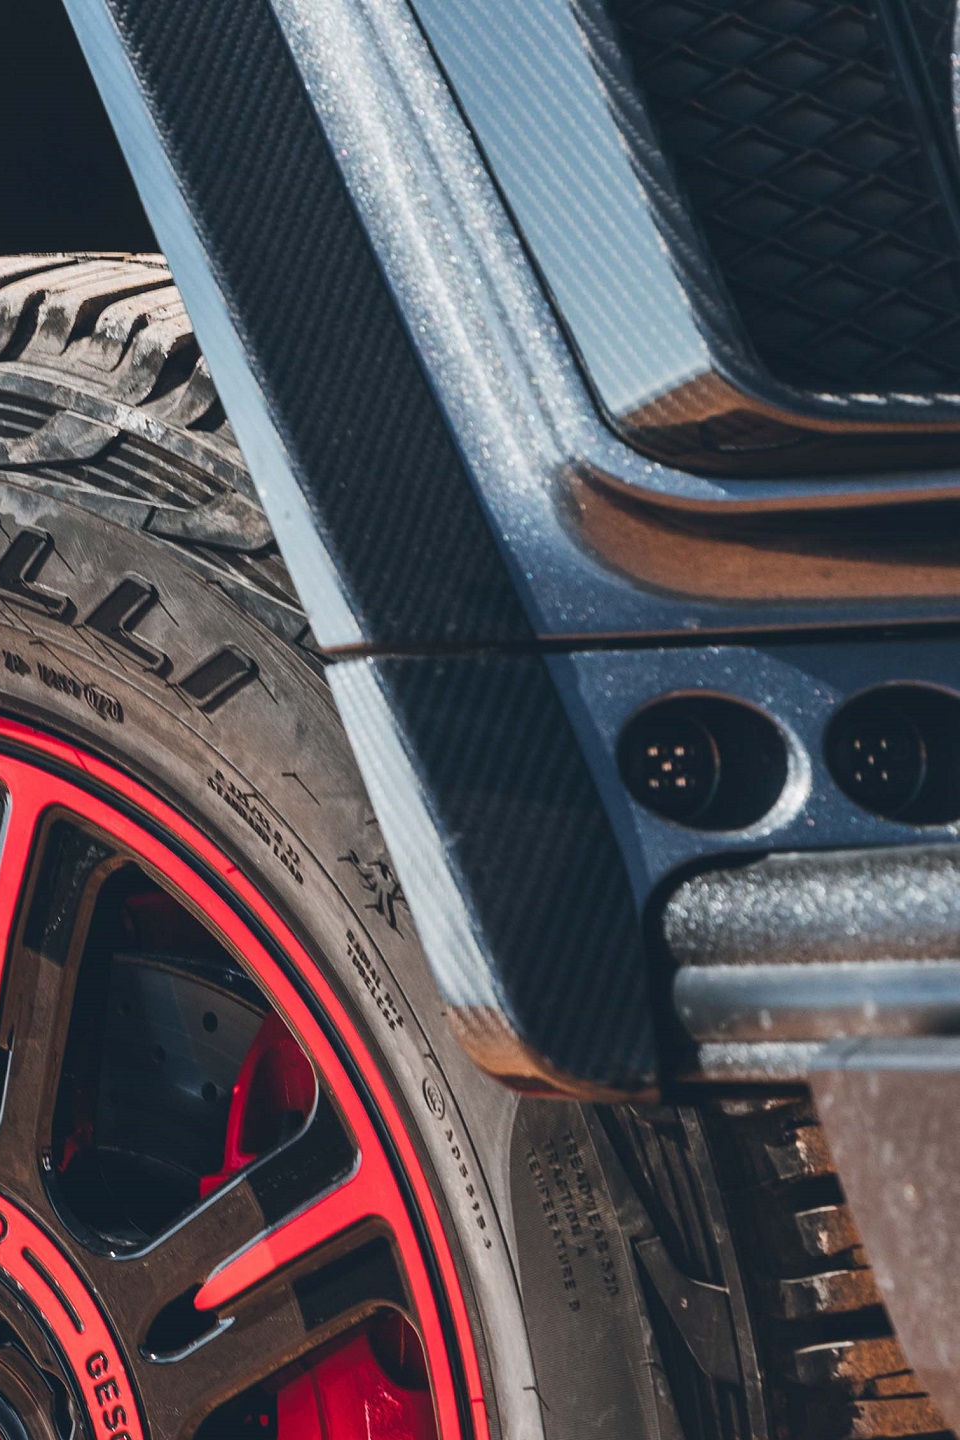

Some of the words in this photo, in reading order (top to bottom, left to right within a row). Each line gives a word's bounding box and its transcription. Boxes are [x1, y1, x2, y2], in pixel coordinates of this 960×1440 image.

[273, 844, 304, 885] LOAD
[346, 945, 396, 1031] TUBELESS
[528, 1147, 577, 1291] TEMPERATURE
